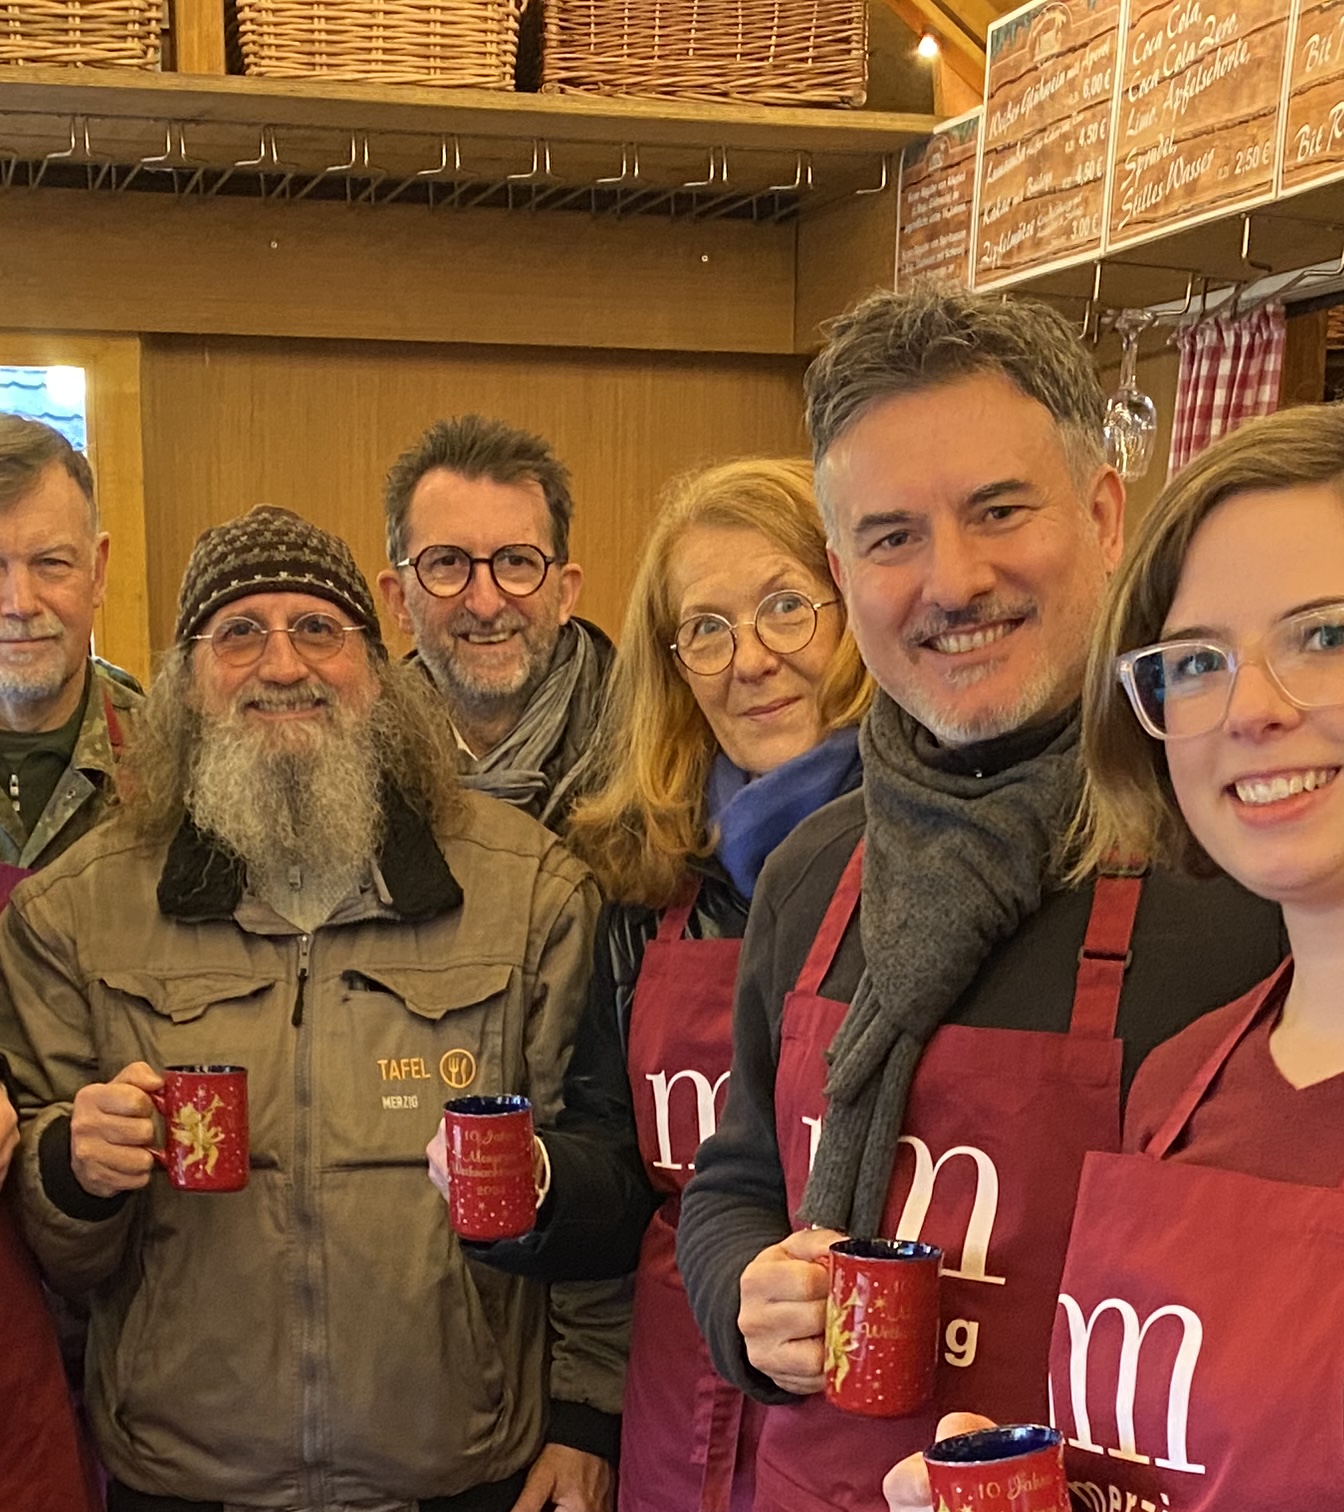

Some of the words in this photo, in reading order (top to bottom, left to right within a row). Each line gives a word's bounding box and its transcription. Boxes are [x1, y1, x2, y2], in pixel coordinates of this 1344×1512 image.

[1133, 30, 1164, 66] Coca
[1167, 0, 1202, 39] Cola,
[1303, 31, 1333, 73] Bit
[1128, 68, 1160, 103] Coca
[1163, 40, 1196, 77] Cola
[1120, 127, 1179, 192] Sprudel,
[1294, 123, 1323, 164] Bit
[1117, 181, 1164, 232] Stilles
[1165, 148, 1216, 196] Wasser
[1234, 145, 1261, 177] 2,50
[1261, 139, 1272, 165] €
[377, 1057, 431, 1081] TAFEL
[382, 1094, 419, 1110] MERZIG
[978, 1482, 1001, 1500] 10
